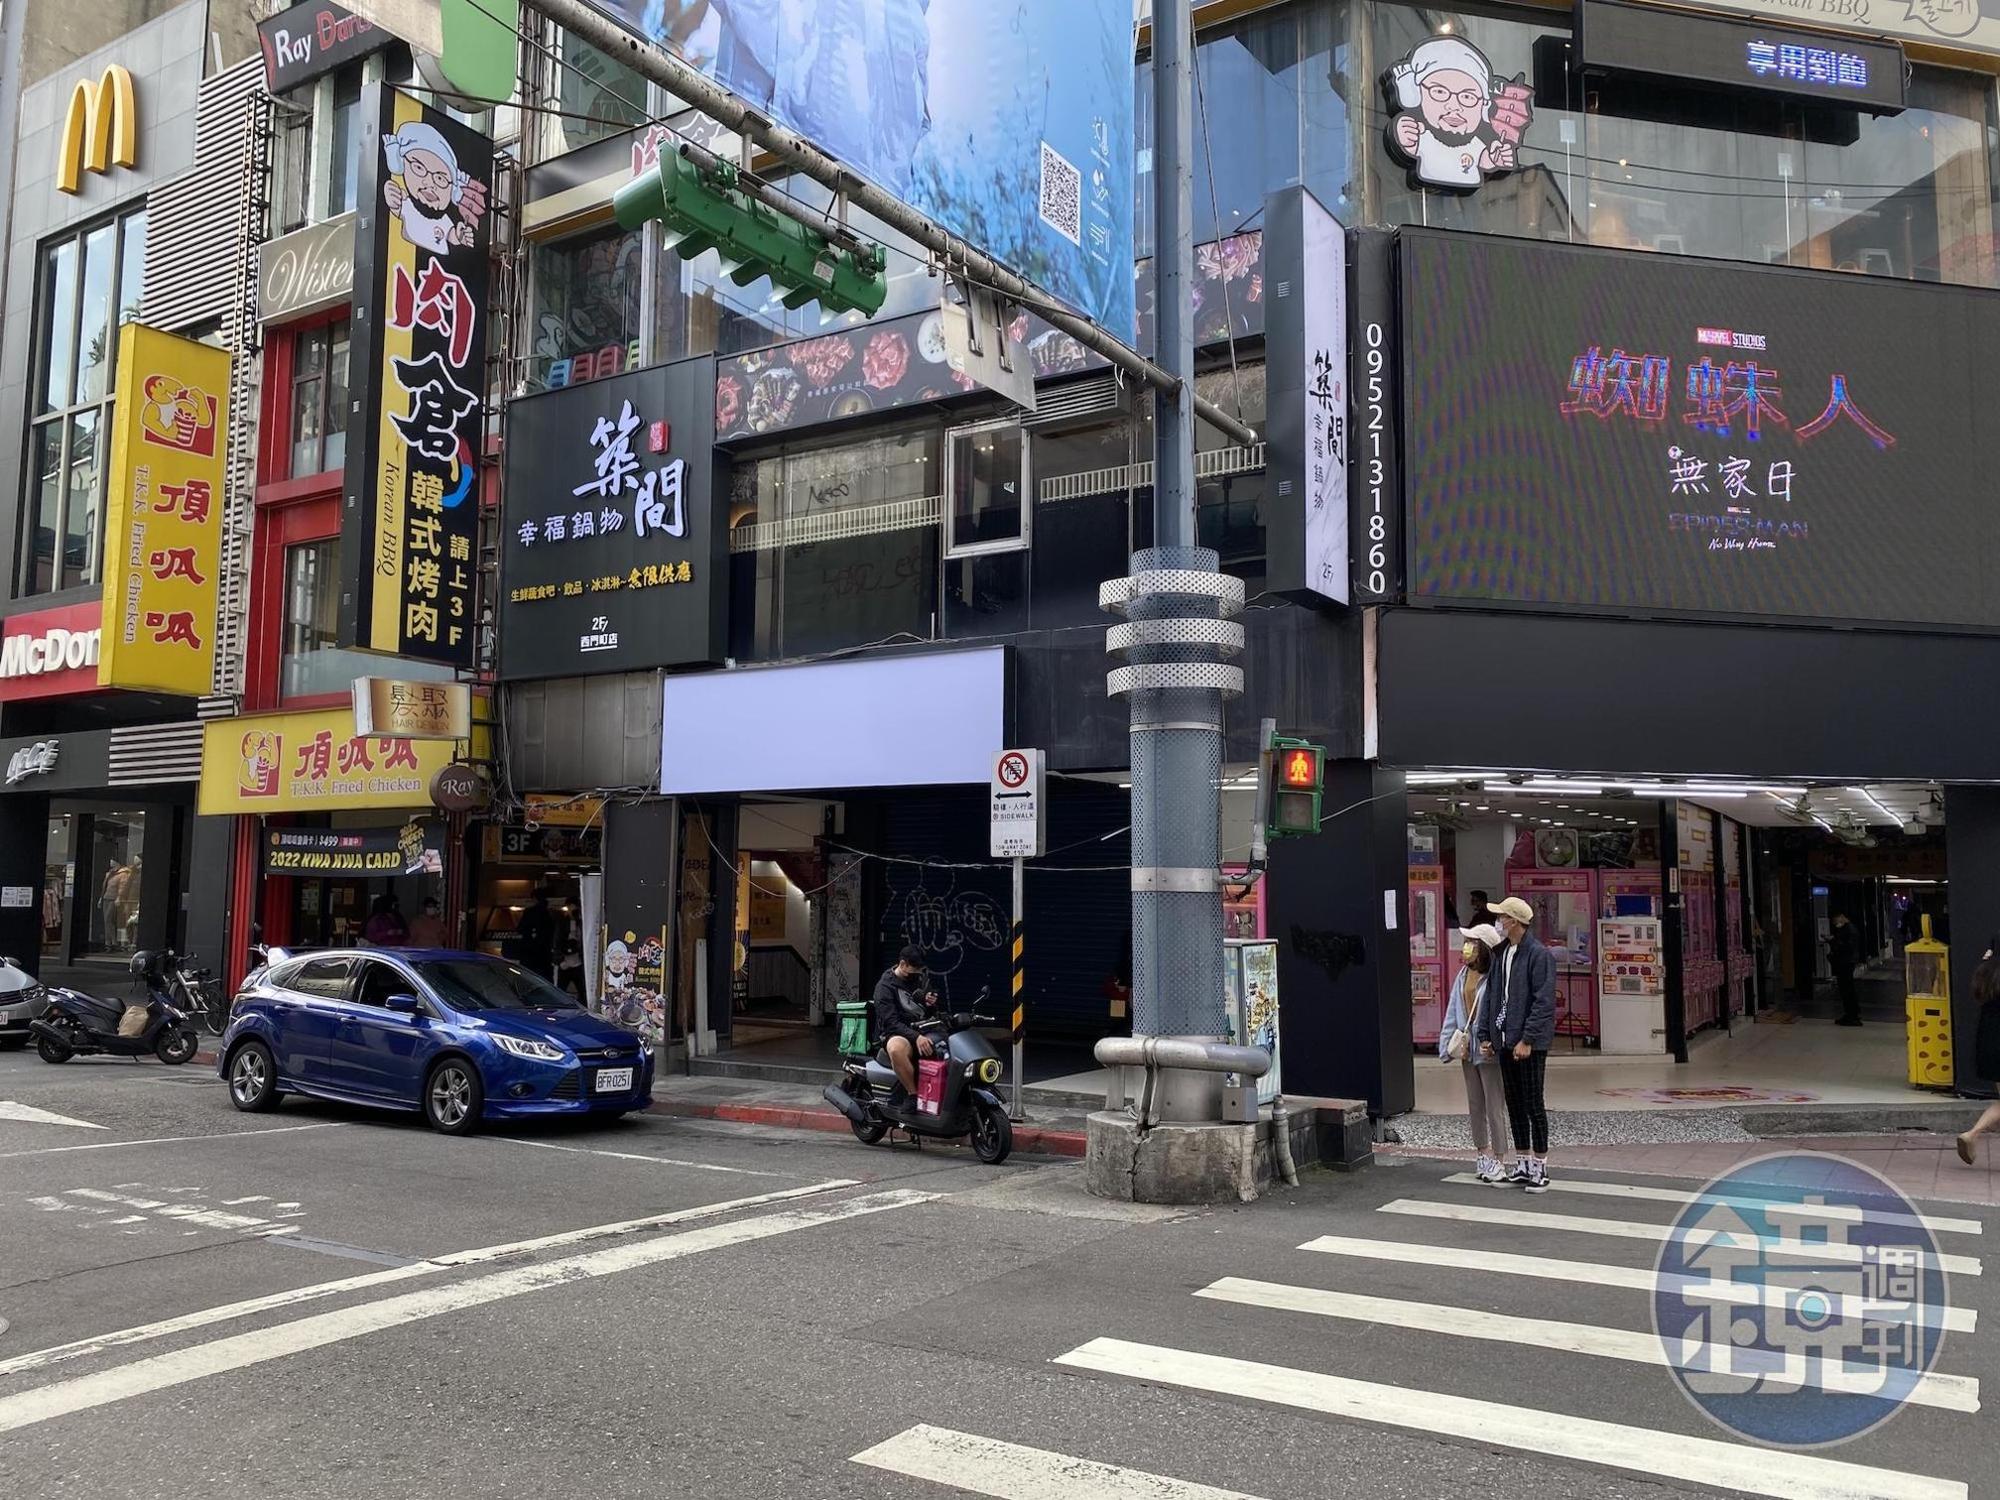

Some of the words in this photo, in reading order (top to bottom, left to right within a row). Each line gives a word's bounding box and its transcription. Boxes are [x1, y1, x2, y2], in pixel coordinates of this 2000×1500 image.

[275, 29, 312, 68] Ray
[1747, 40, 1868, 87] 享用到飽
[1697, 327, 1732, 346] MARVEL
[1732, 332, 1767, 351] STUDIOS
[1560, 347, 1896, 444] 蜘蛛人
[572, 399, 684, 537] 築間
[1366, 323, 1387, 595] 0952131860
[1668, 455, 1797, 502] 無家日
[134, 465, 149, 517] T.K.K.
[384, 462, 400, 529] Korean
[130, 521, 145, 567] Fried
[517, 506, 623, 547] 幸福鍋物
[146, 480, 210, 650] 頂呱呱
[376, 530, 397, 577] BBQ
[406, 469, 445, 643] 韓式烤肉
[124, 572, 143, 645] Chicken
[448, 533, 471, 646] 請上3F
[580, 633, 618, 648] 西門町店
[392, 719, 414, 729] HAIR
[294, 731, 418, 780] 頂呱呱
[291, 781, 326, 796] T.K.K.
[331, 780, 364, 794] Fried
[368, 777, 420, 792] Chicken
[441, 778, 475, 797] Ray
[270, 851, 300, 867] 2022
[300, 853, 331, 868] KWA
[331, 853, 364, 869] KWA
[365, 852, 401, 869] CARD
[319, 835, 339, 847] $499
[507, 834, 531, 852] 3F
